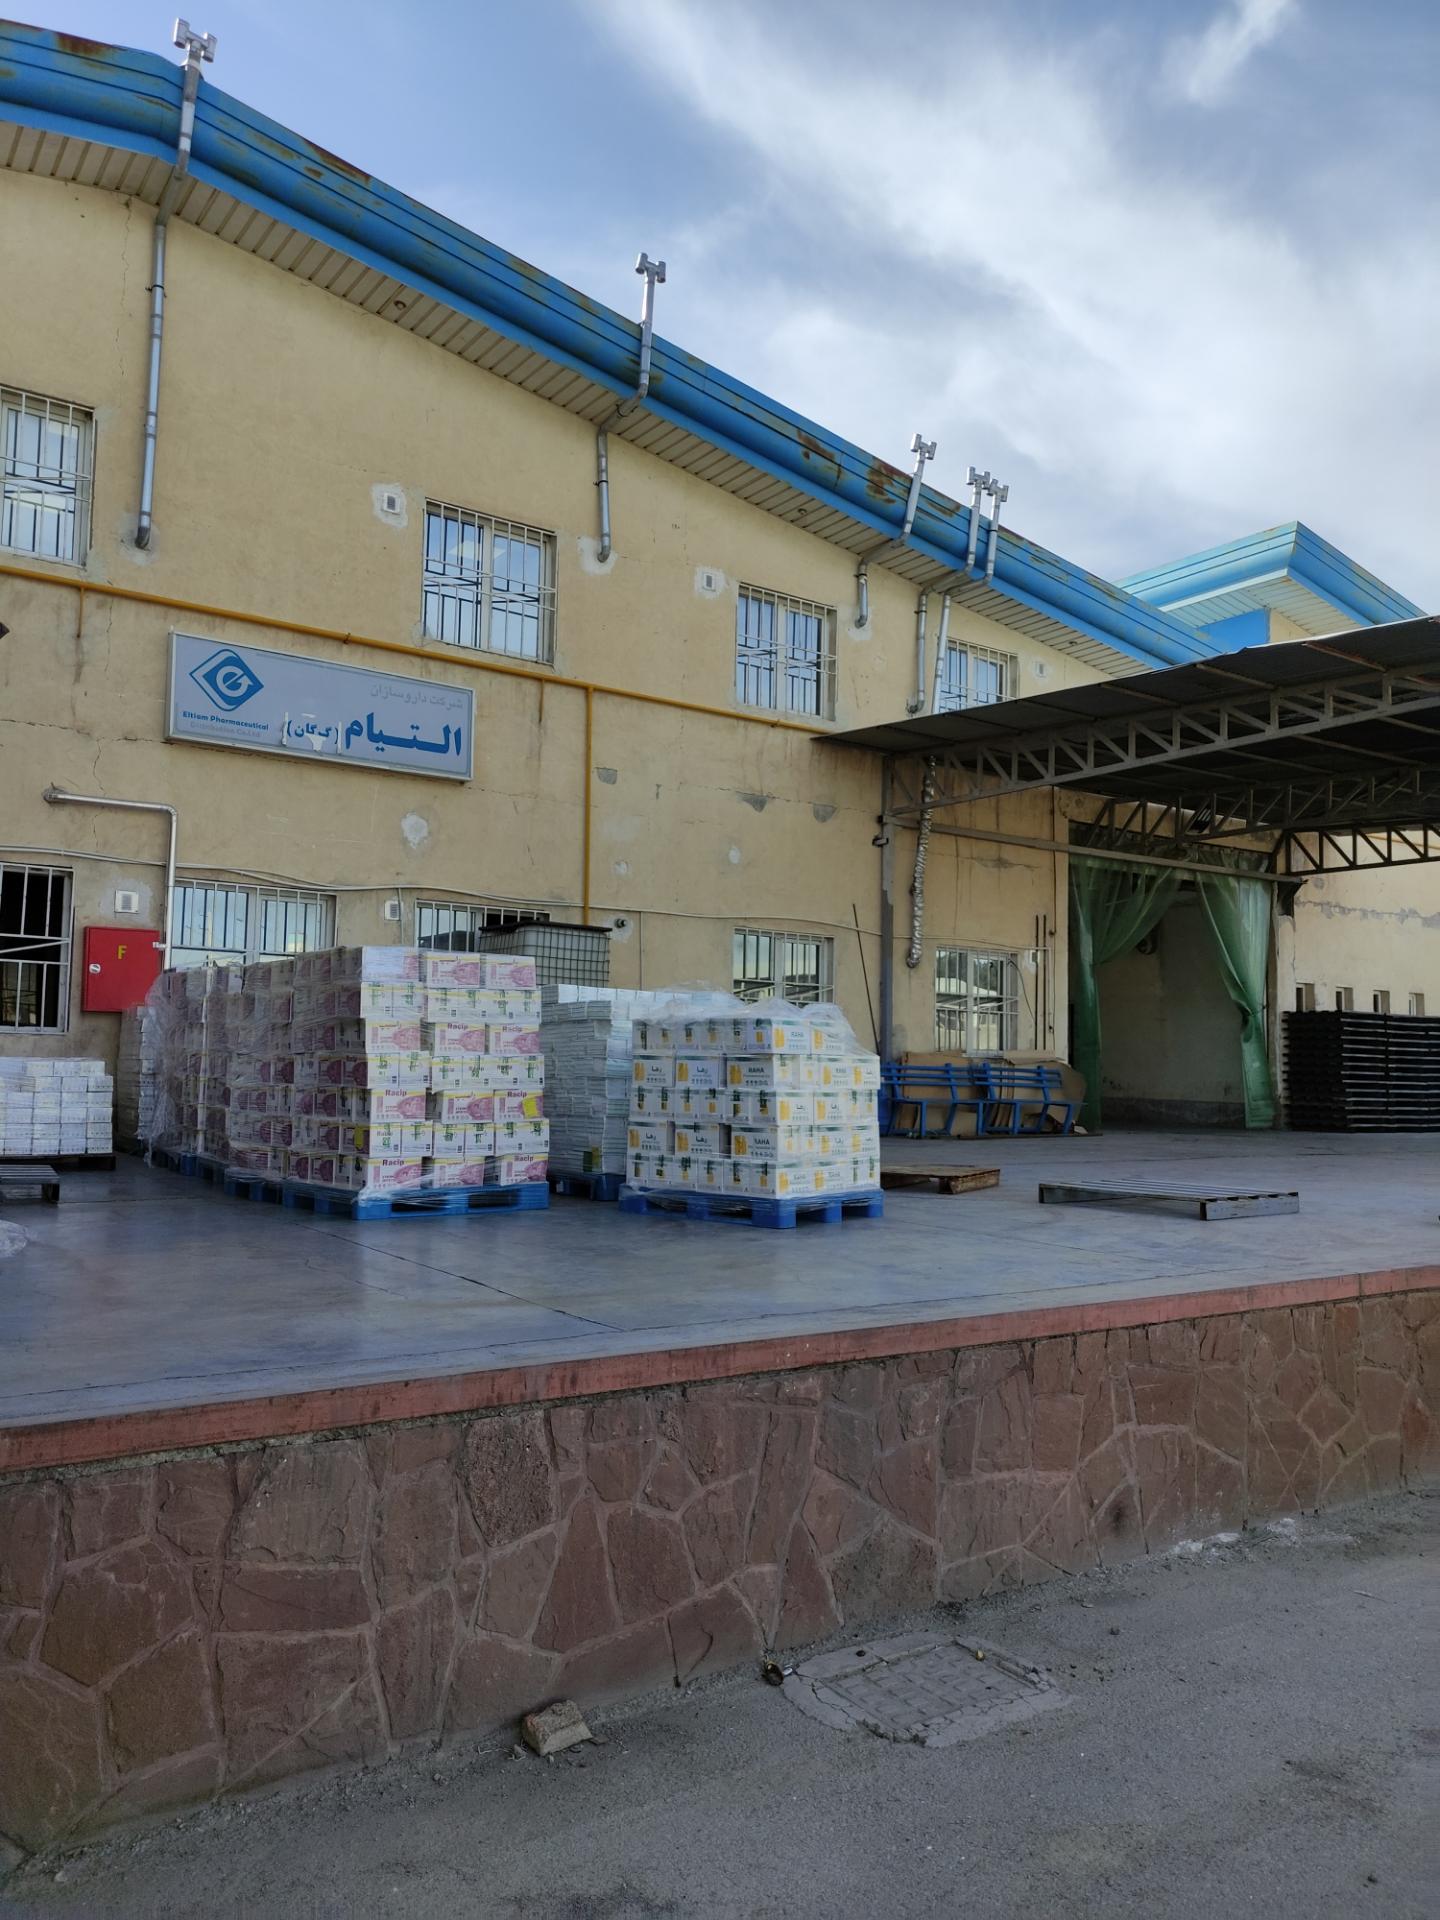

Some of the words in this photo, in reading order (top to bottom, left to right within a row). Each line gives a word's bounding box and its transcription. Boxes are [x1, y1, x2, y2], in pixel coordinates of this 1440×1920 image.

[429, 696, 463, 711] شرکت
[182, 711, 209, 721] Eltiam
[210, 714, 269, 730] Pharmaceutical
[345, 711, 462, 756] التیام
[118, 944, 127, 960] F
